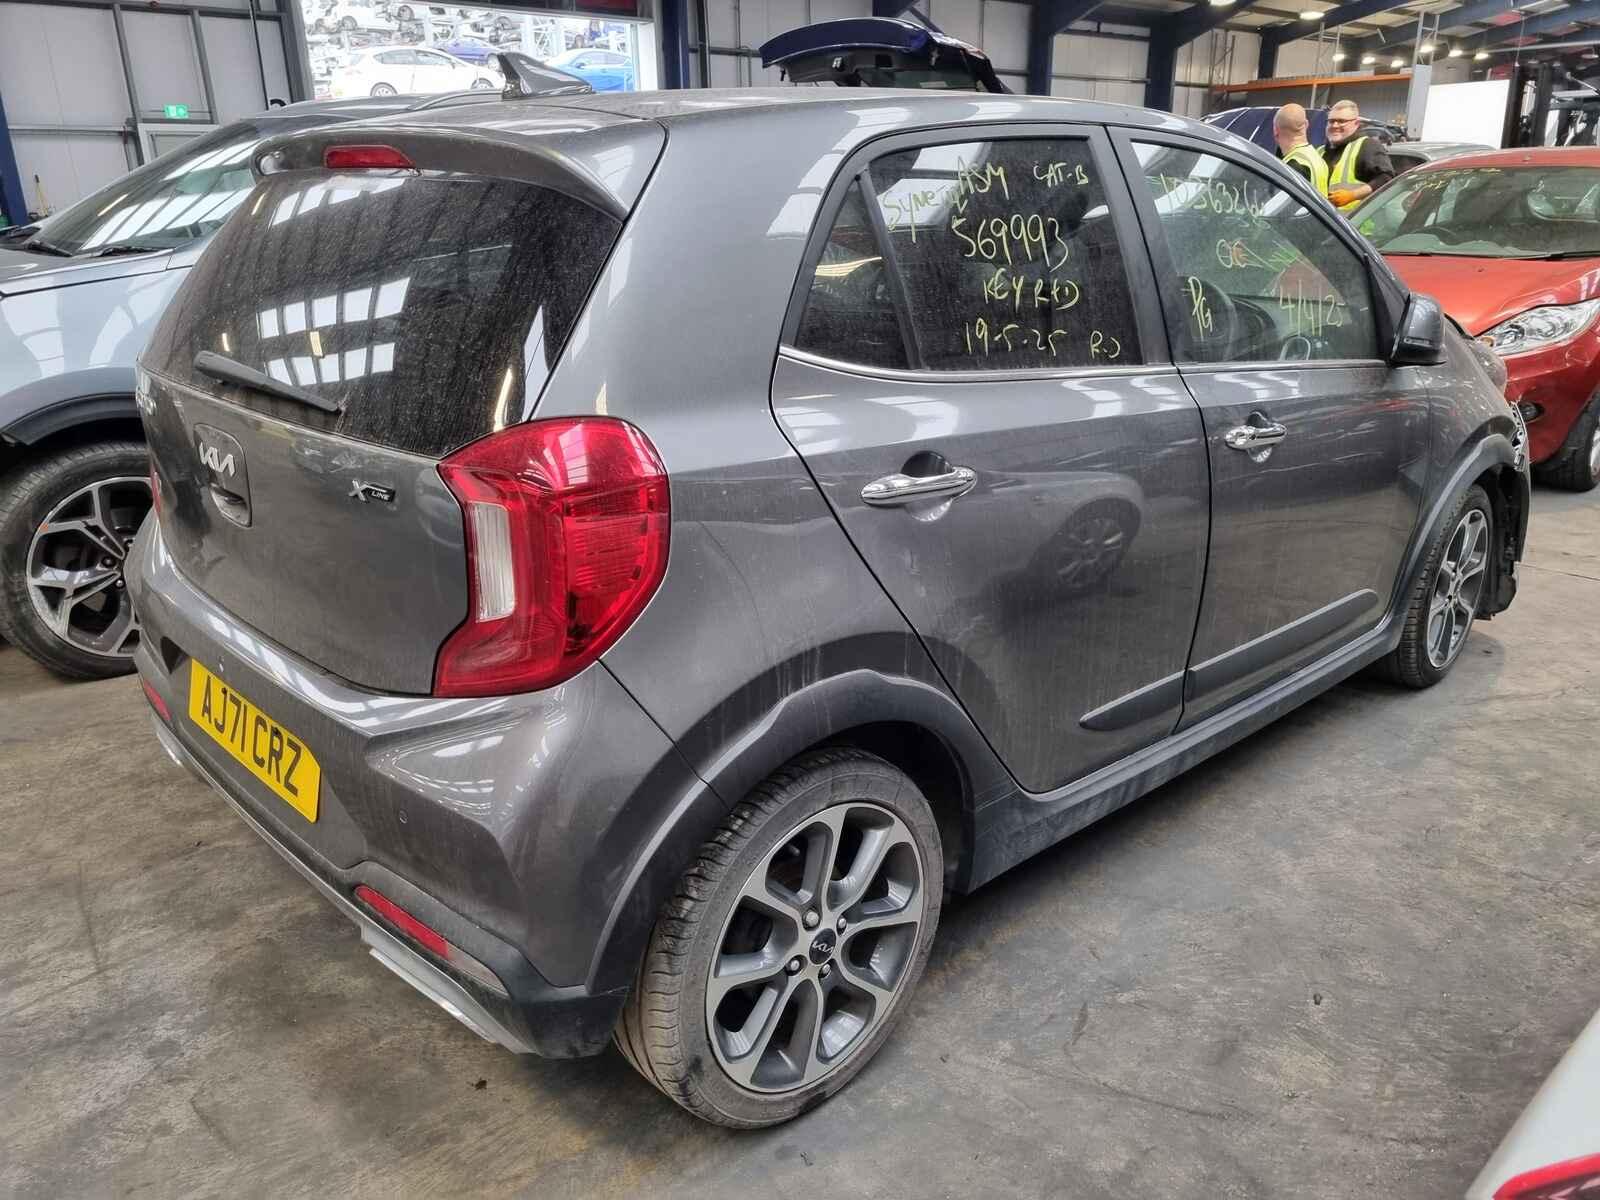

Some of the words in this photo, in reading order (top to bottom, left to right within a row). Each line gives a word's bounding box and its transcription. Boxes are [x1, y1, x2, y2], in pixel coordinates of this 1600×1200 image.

[952, 213, 1069, 273] 569993
[983, 267, 1024, 313] KEY
[198, 441, 236, 478] KIA
[812, 940, 834, 954] KIA
